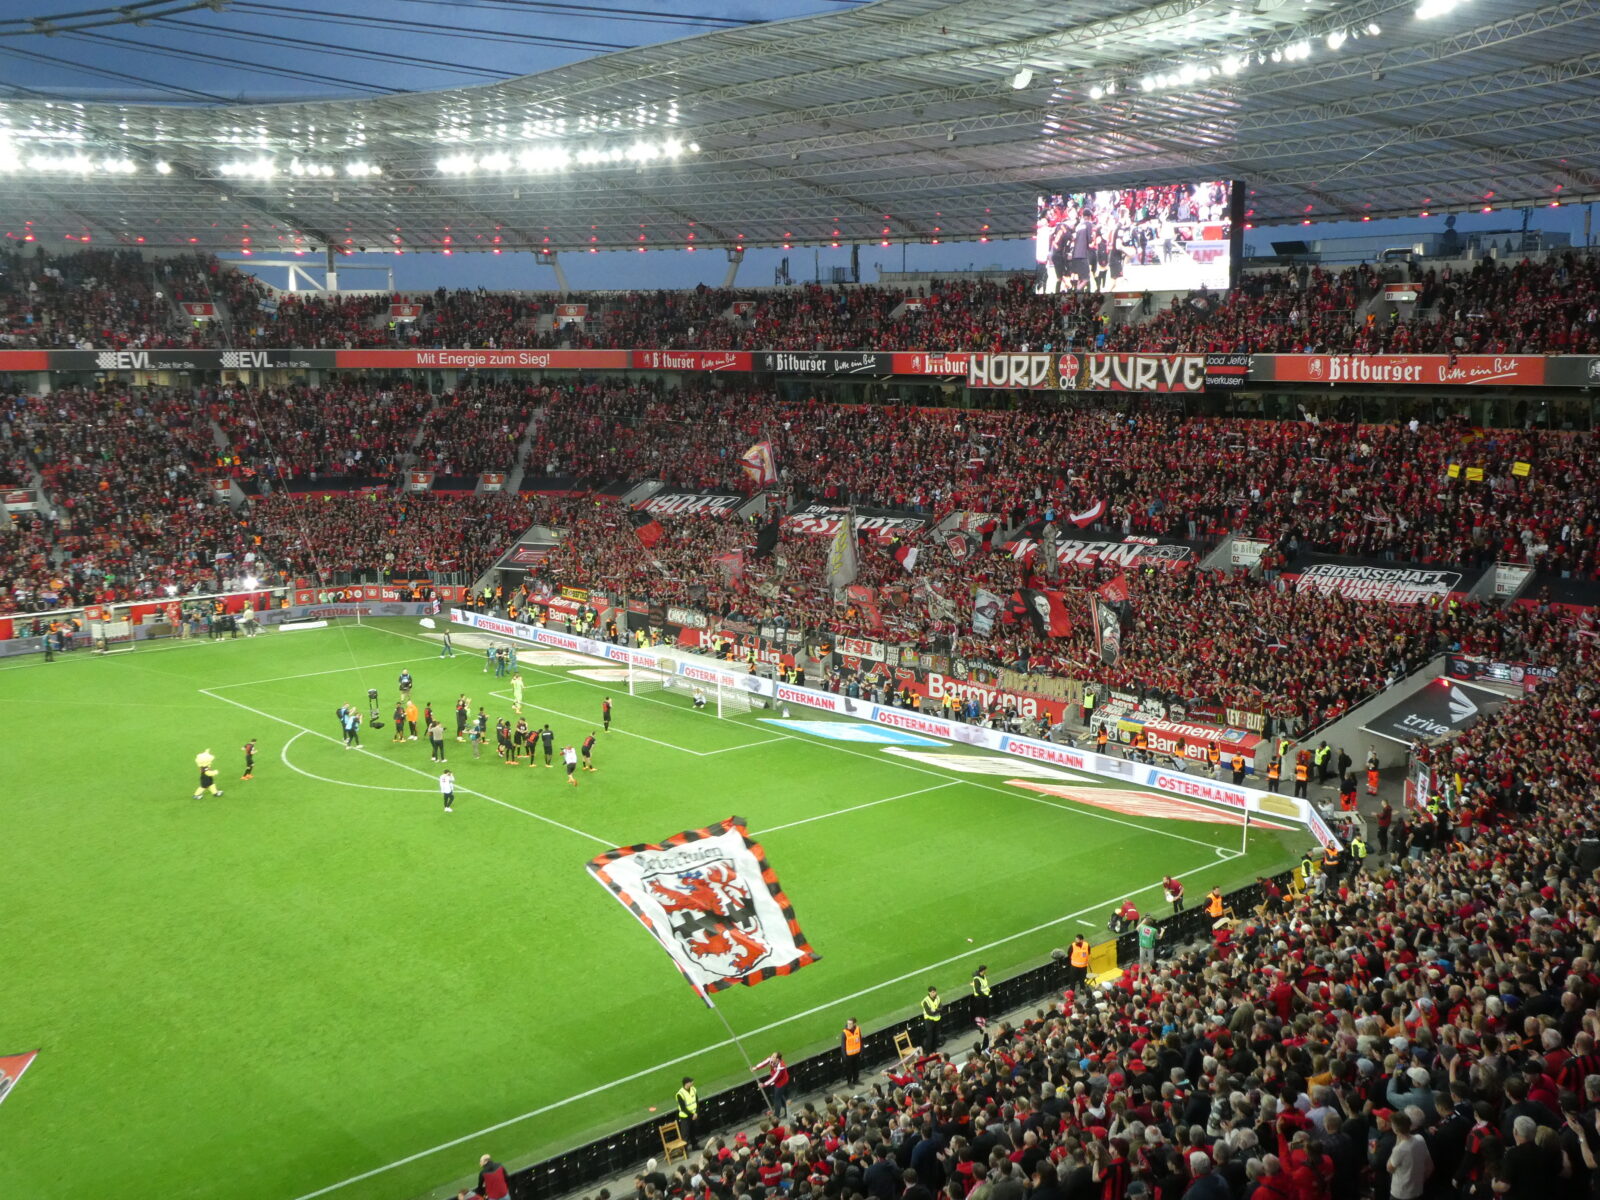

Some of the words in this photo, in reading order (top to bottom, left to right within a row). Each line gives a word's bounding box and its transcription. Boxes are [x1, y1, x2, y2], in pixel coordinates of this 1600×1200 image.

[239, 352, 273, 368] EVL
[417, 353, 435, 364] Mit
[439, 353, 486, 367] Energie
[490, 355, 515, 364] zum
[519, 353, 550, 367] Sieg!
[776, 354, 826, 371] Bitburger
[1329, 357, 1422, 382] Bitburger
[1439, 365, 1466, 381] Bitte
[1470, 366, 1492, 376] ein
[1494, 358, 1519, 373] Bit
[1090, 355, 1205, 390] KURVE
[1060, 376, 1077, 389] 04
[1302, 574, 1408, 591] EMOTIONEN
[1307, 565, 1448, 583] LEIDENSCHAFT
[477, 619, 514, 635] OSTERMANN
[538, 632, 578, 650] OSTERMANN
[610, 649, 656, 667] OSTEMANN
[685, 667, 735, 687] OSTERMNN
[778, 688, 836, 710] OSTERMANN
[1144, 717, 1222, 741] Barmeni
[1403, 714, 1450, 735] trive
[1009, 741, 1084, 768] OSTERMANN
[1157, 776, 1247, 807] OSTERMANN
